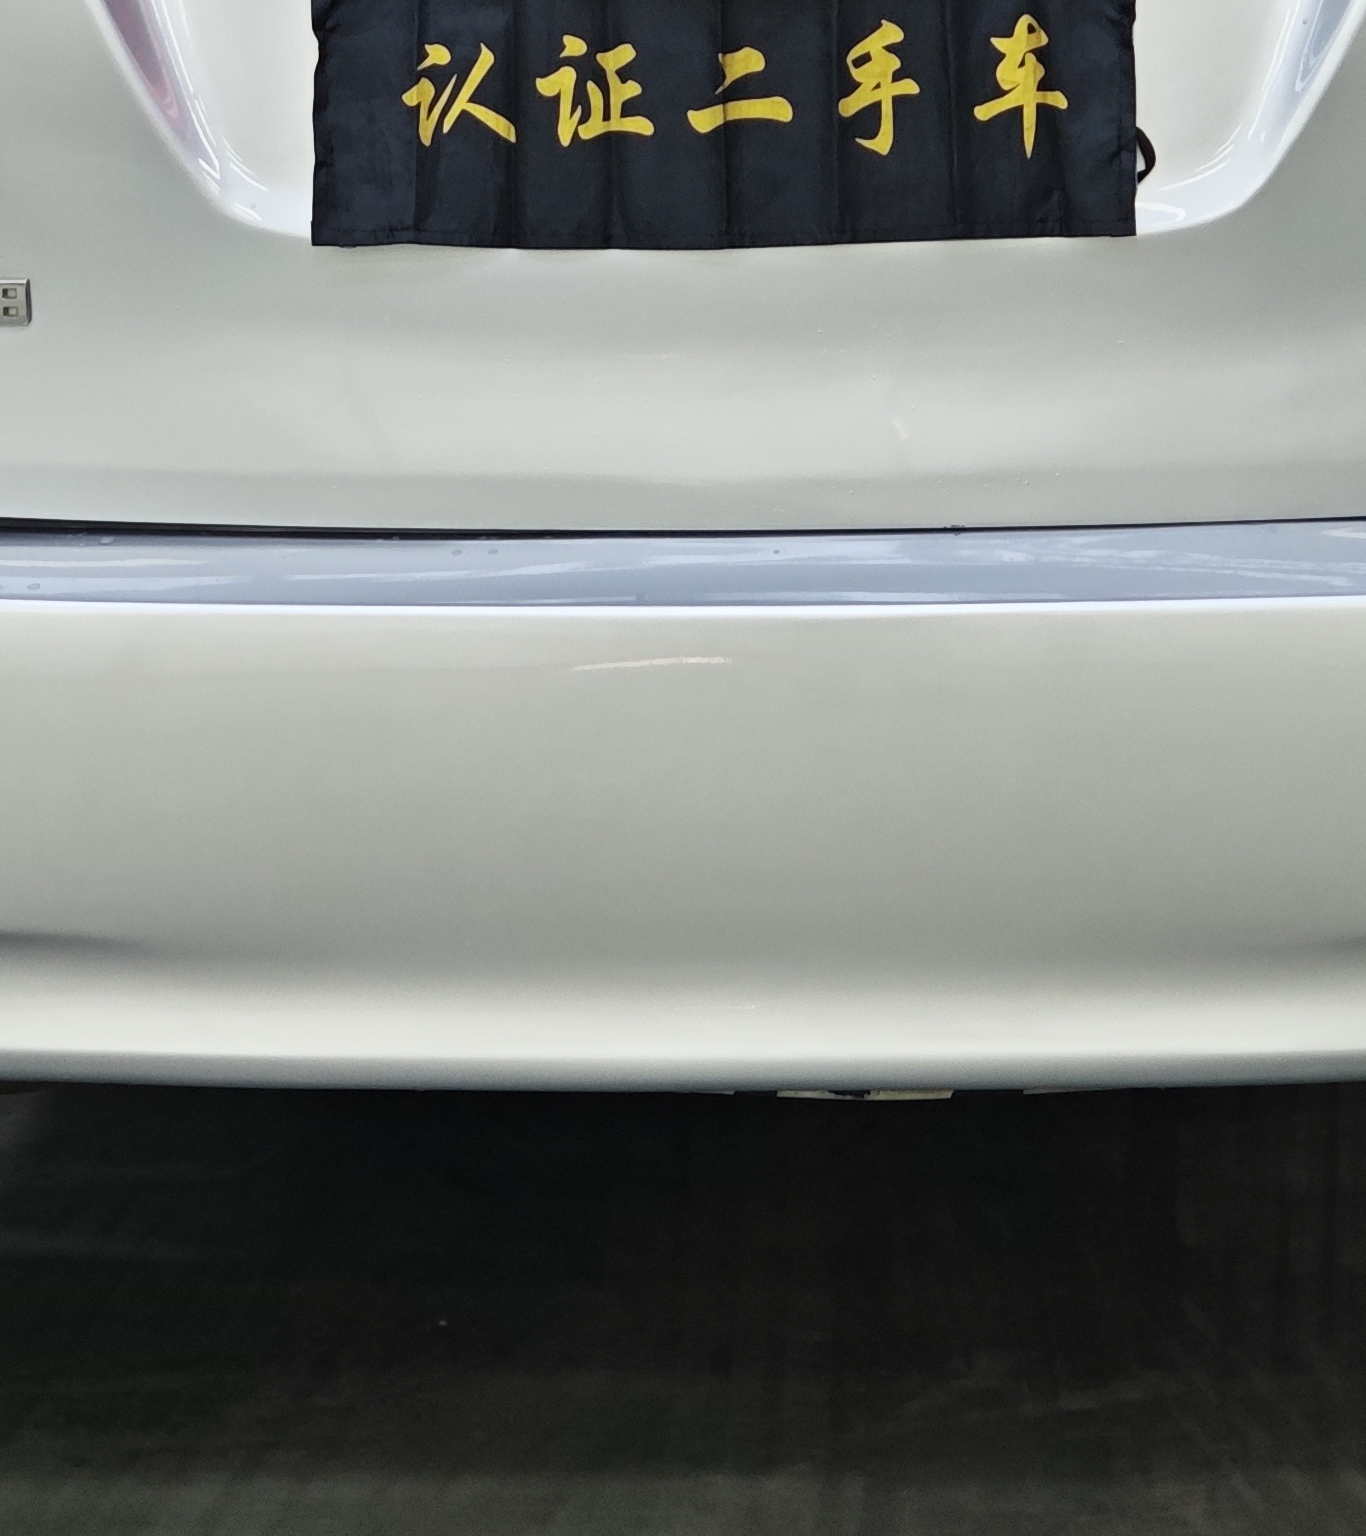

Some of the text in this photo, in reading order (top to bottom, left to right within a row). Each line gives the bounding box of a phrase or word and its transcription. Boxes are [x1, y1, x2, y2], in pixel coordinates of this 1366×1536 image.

[401, 13, 1069, 159] 认证二手车
